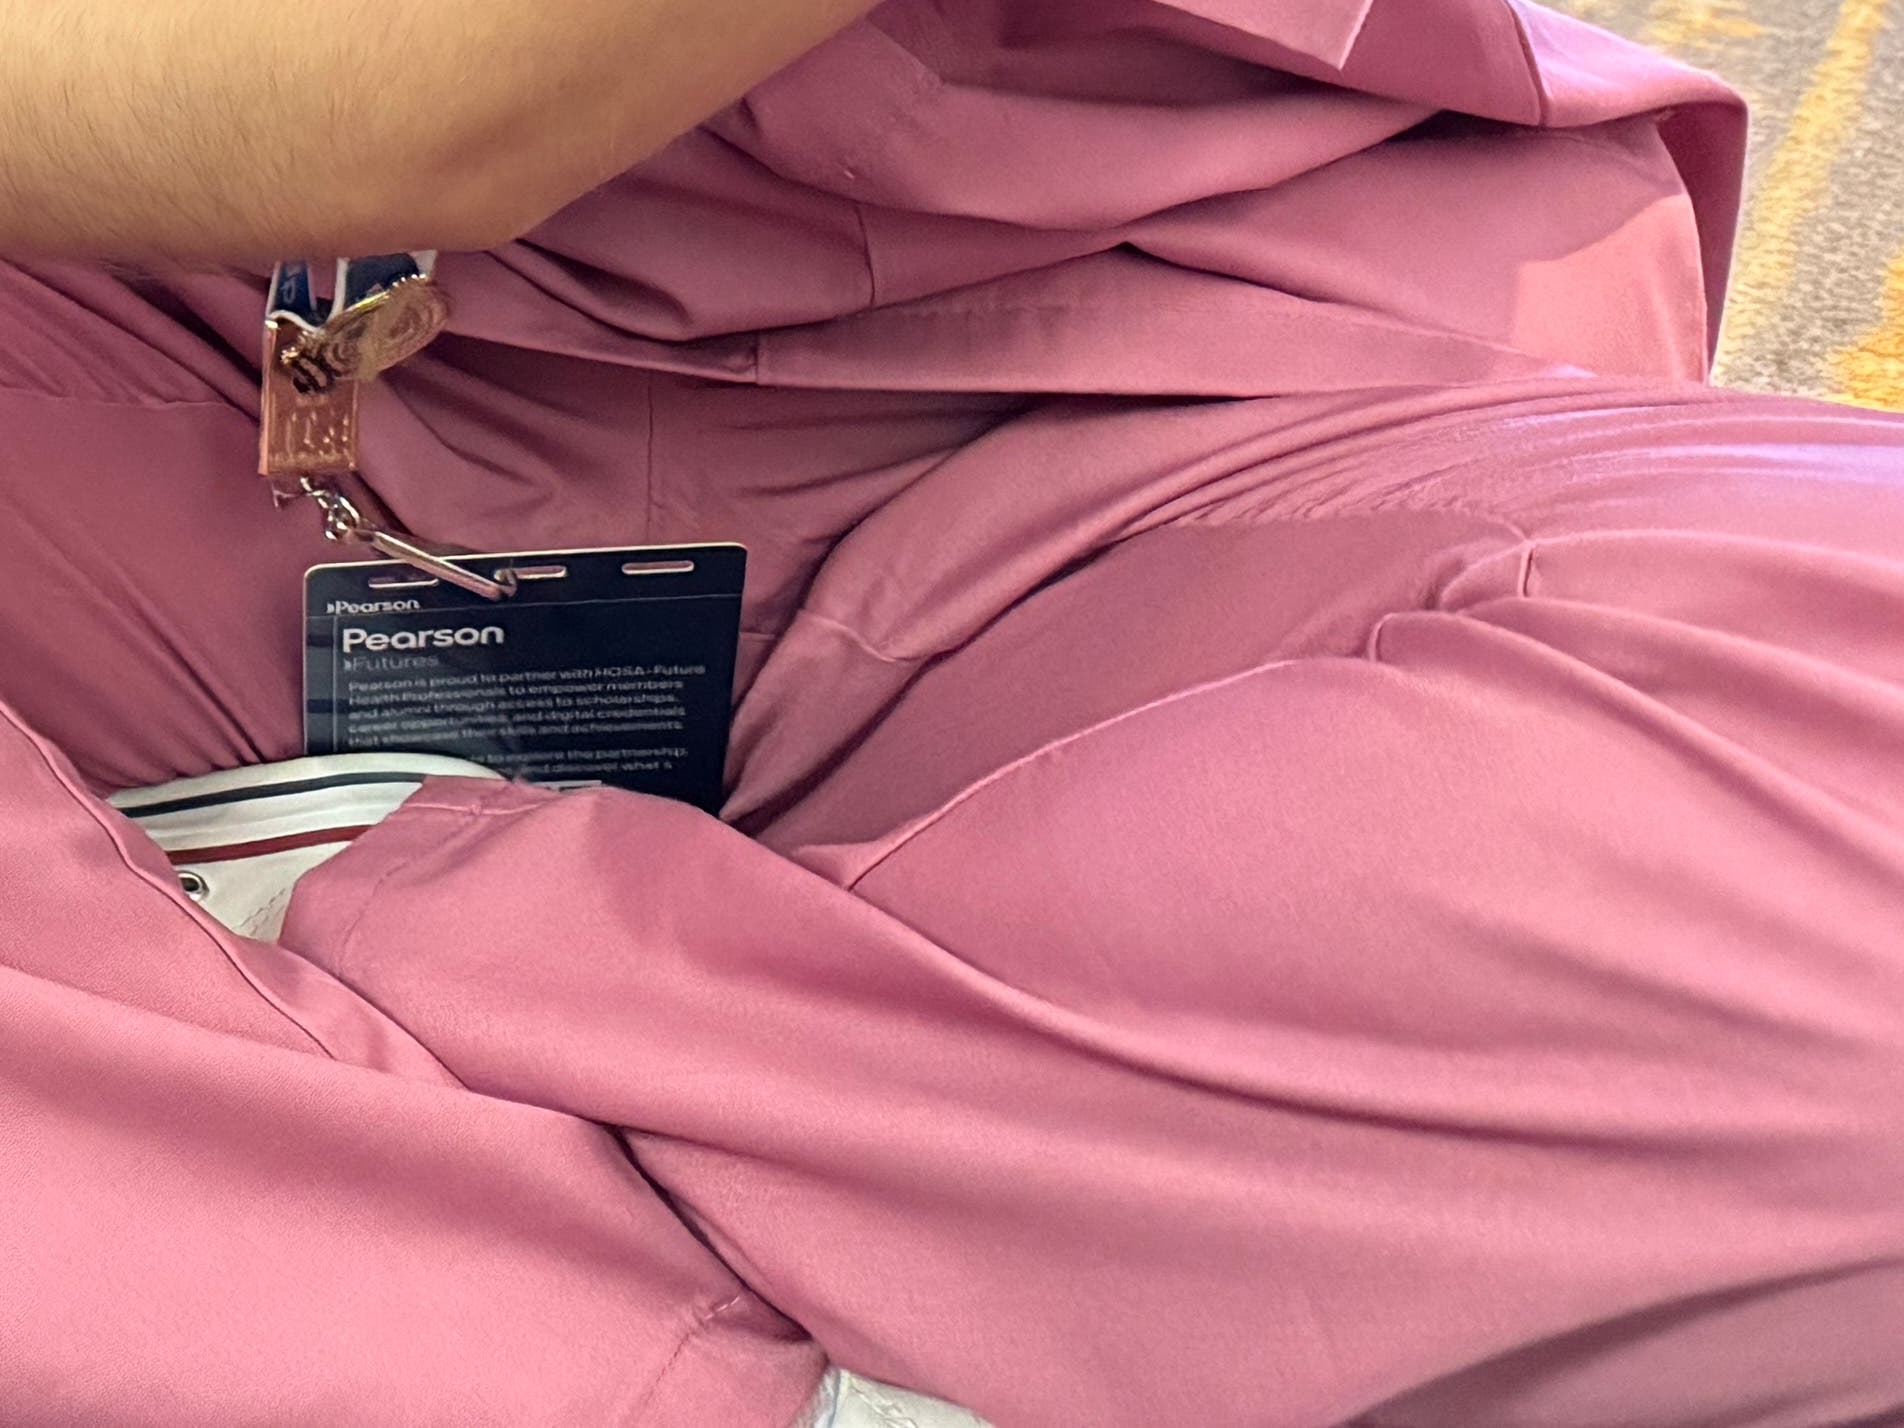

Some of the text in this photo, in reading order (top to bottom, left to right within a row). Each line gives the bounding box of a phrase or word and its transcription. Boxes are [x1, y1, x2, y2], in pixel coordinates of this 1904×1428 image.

[335, 599, 421, 614] Pearson
[343, 626, 505, 653] Pearson
[353, 655, 440, 671] Futures
[429, 674, 478, 687] proud
